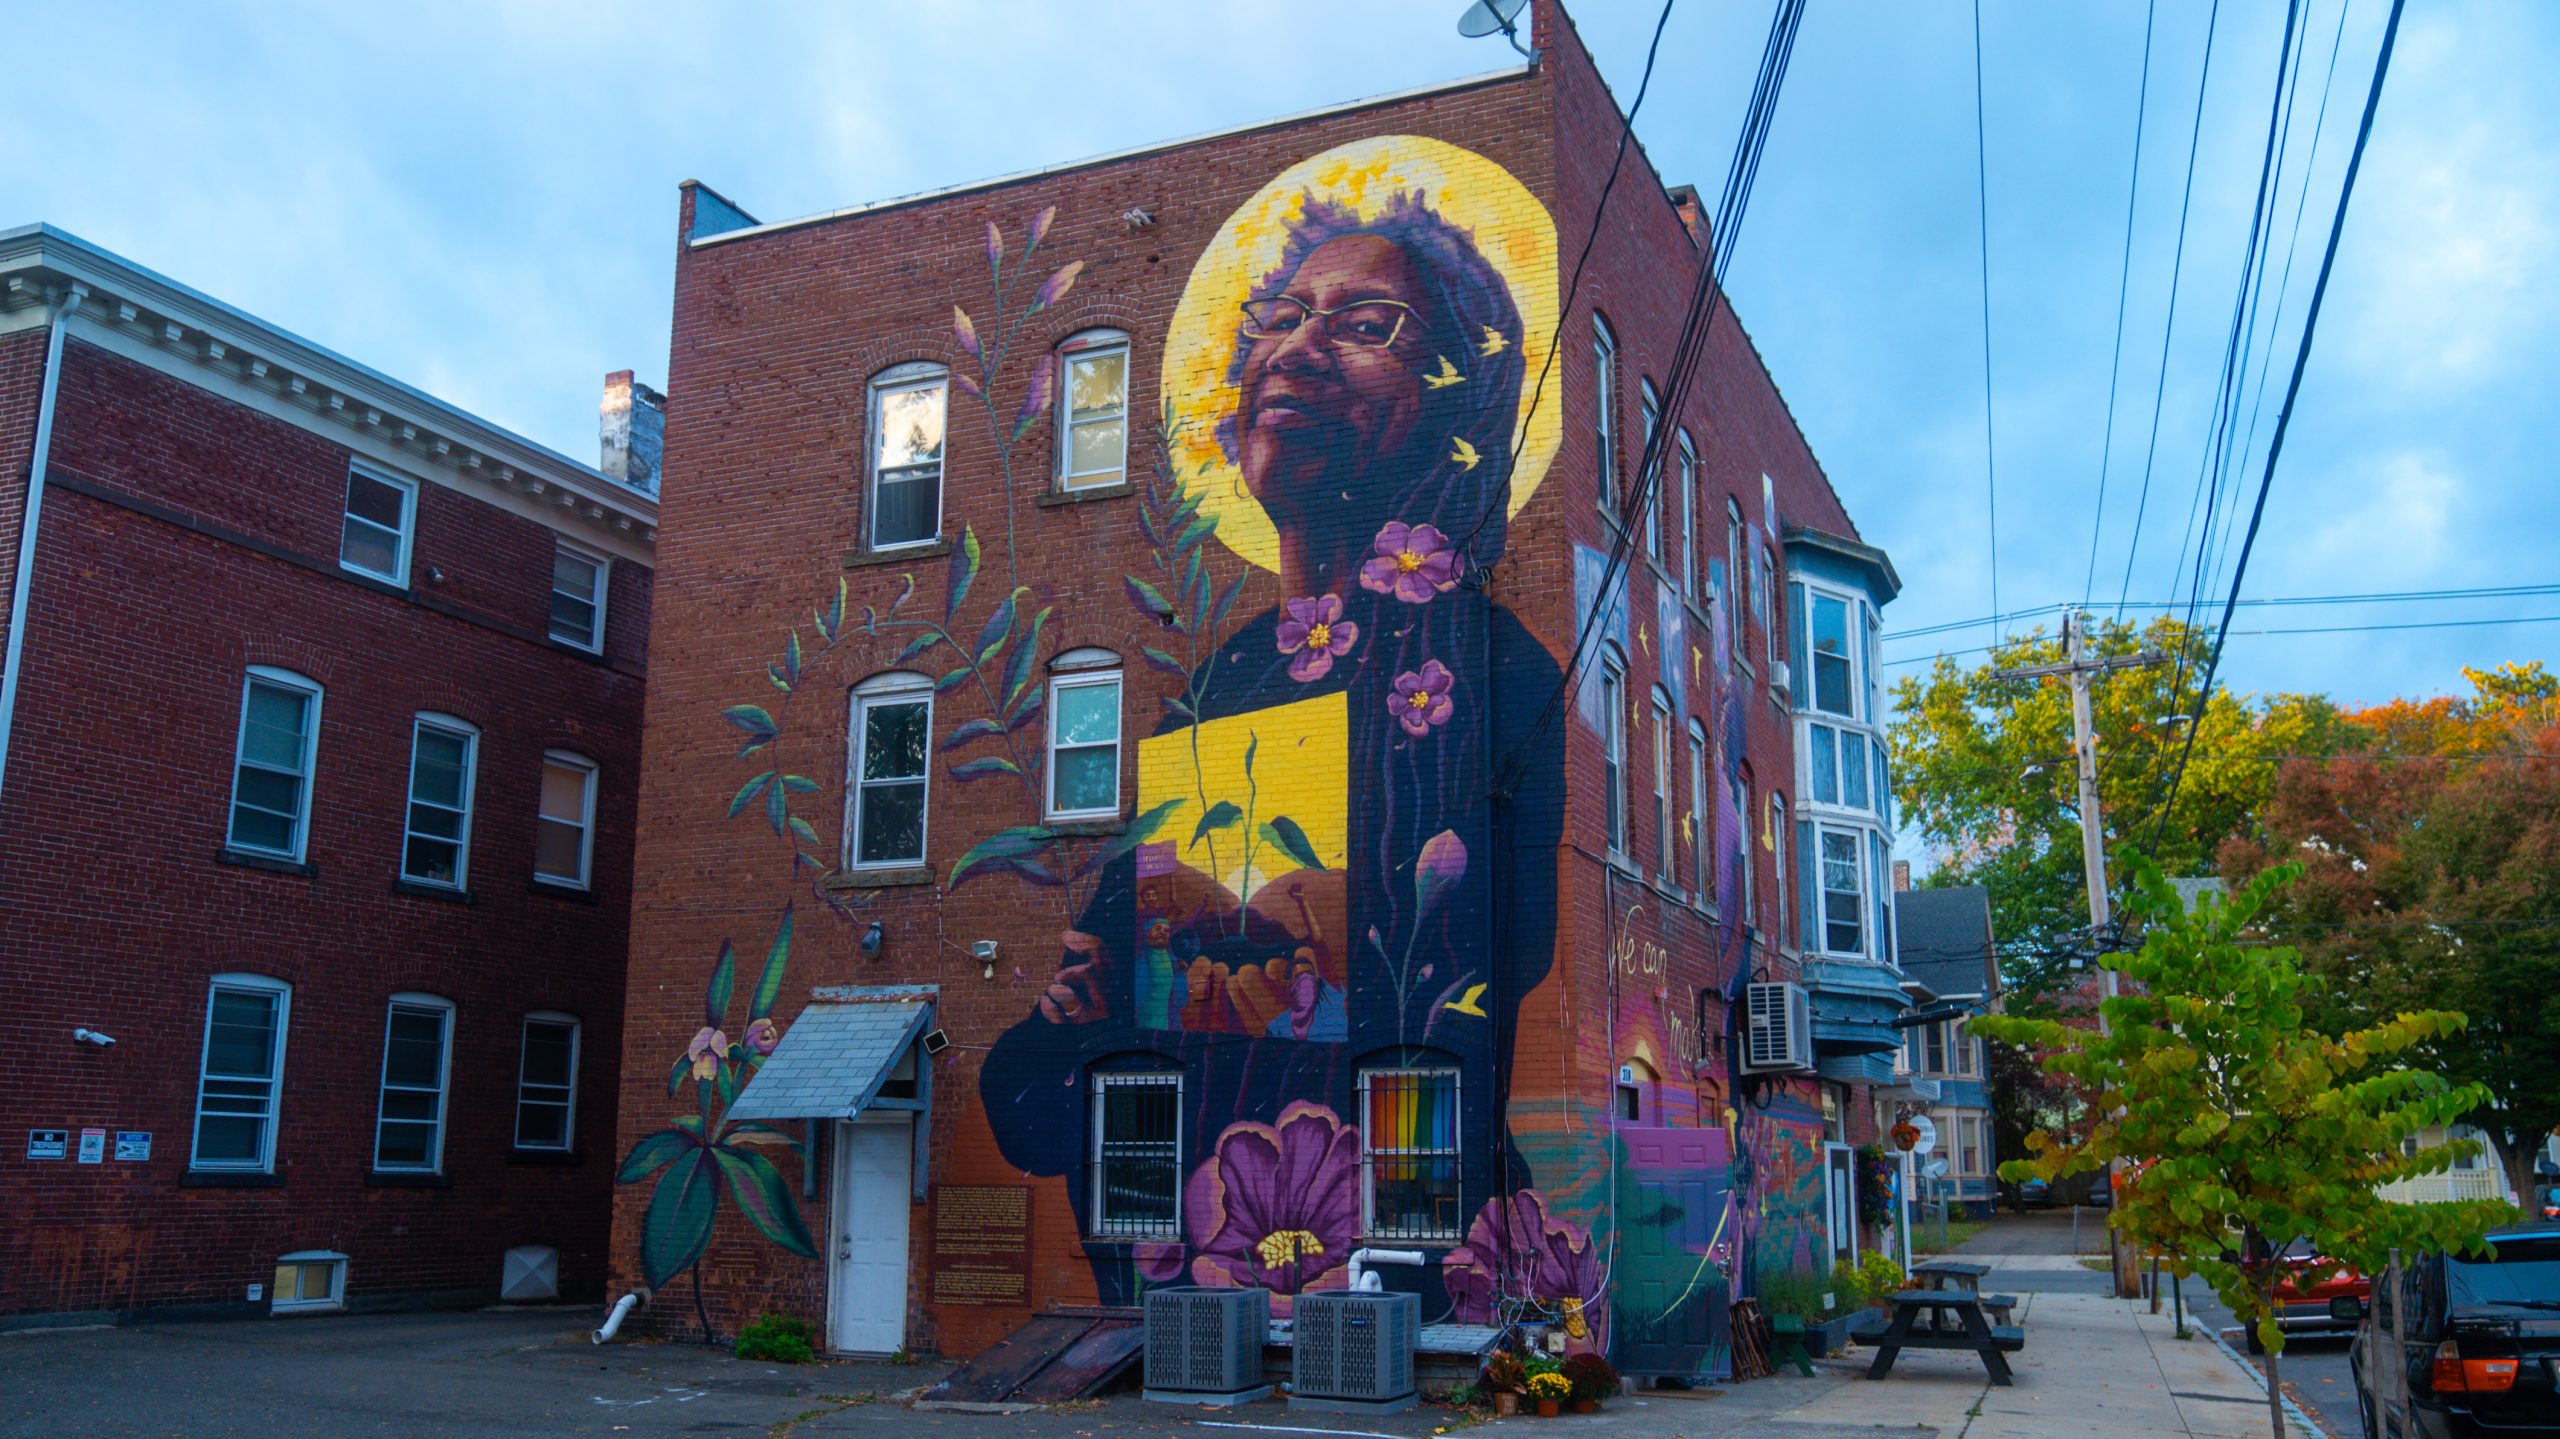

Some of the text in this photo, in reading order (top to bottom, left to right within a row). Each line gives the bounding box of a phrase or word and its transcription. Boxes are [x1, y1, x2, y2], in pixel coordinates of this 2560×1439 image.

[1643, 940, 1667, 983] can
[1919, 1125, 1933, 1133] SIBLE
[44, 1133, 54, 1142] NO
[1920, 1135, 1933, 1143] URES
[32, 1141, 64, 1149] TRESPASSING
